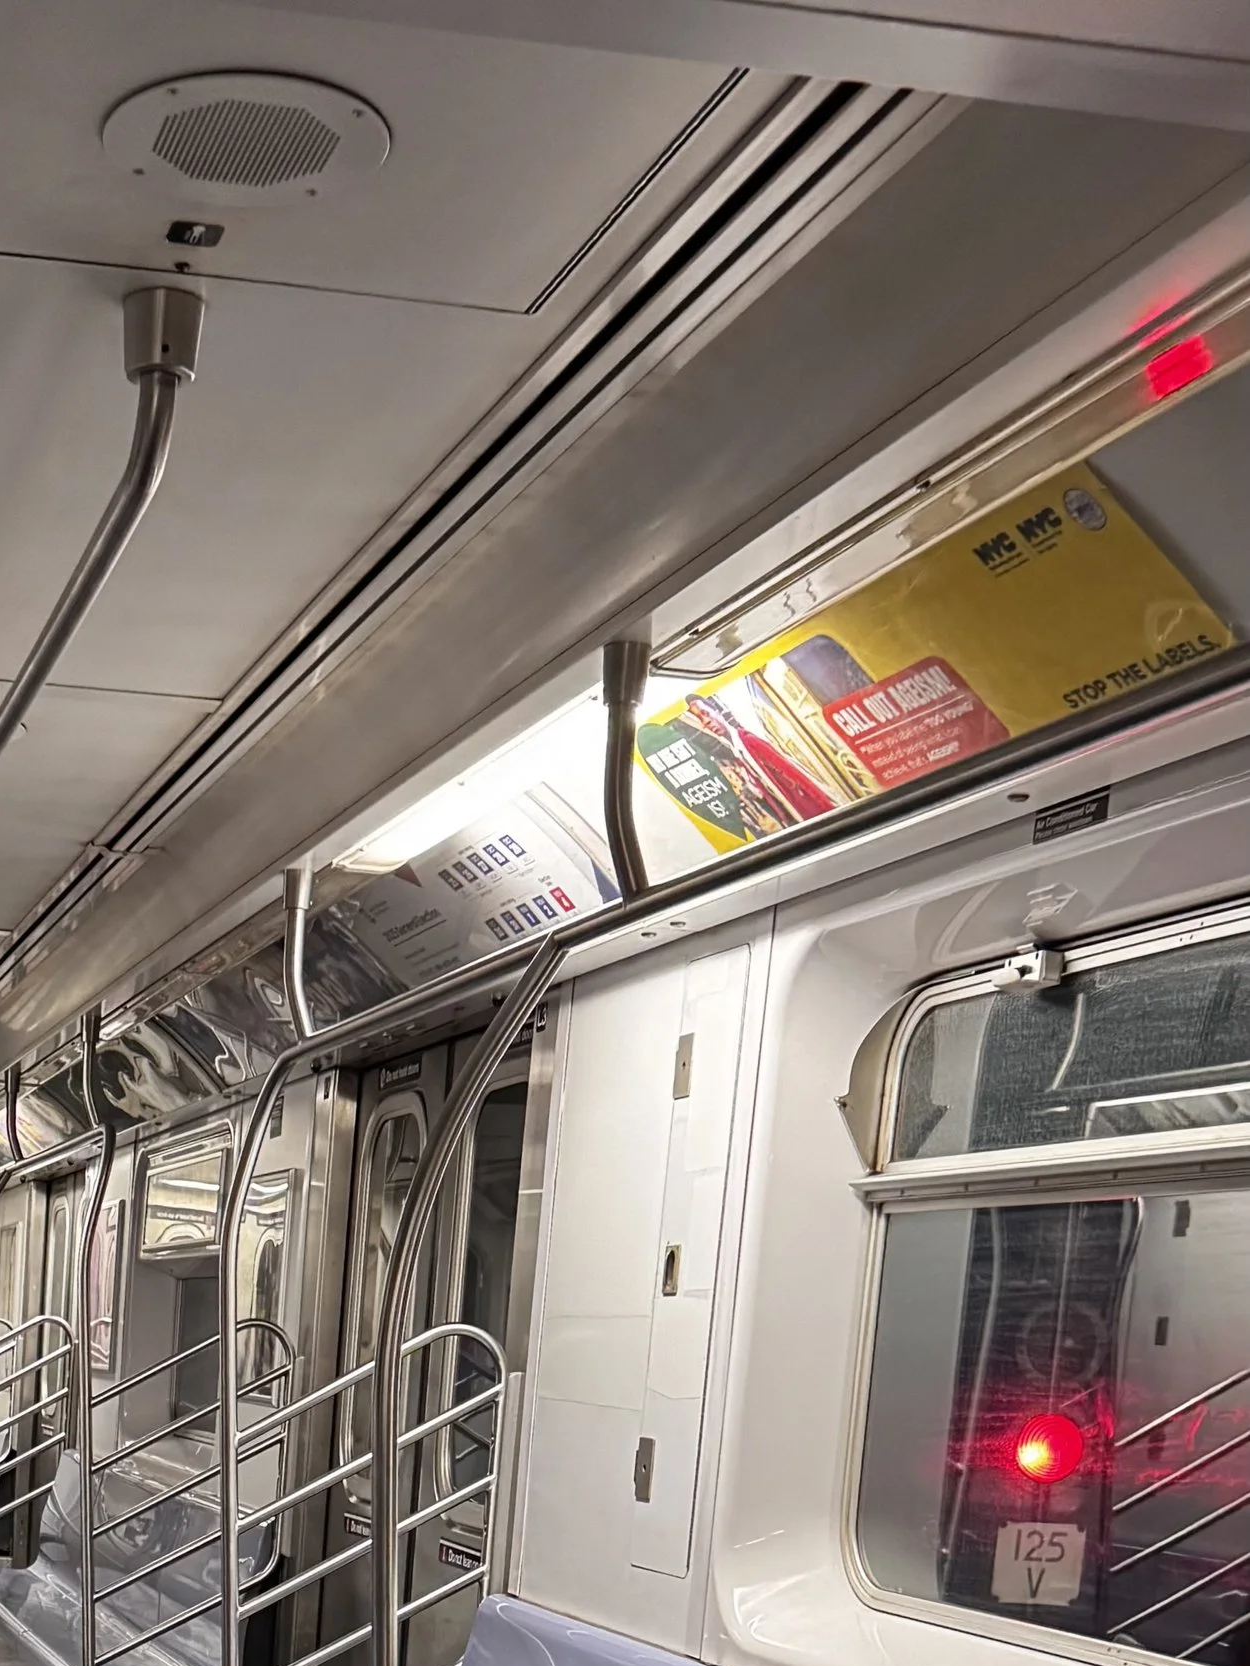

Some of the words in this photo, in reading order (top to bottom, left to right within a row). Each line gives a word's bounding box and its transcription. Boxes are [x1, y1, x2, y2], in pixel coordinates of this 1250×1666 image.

[1016, 507, 1062, 542] NYC
[972, 532, 1017, 565] NYC
[832, 704, 877, 737] CALL
[862, 691, 900, 723] OUT
[887, 665, 958, 713] AGEISM!
[1062, 679, 1108, 709] STOP
[1106, 664, 1147, 690] THE
[681, 776, 728, 808] AGEISM
[1013, 1528, 1067, 1564] 125
[1026, 1567, 1047, 1600] V
